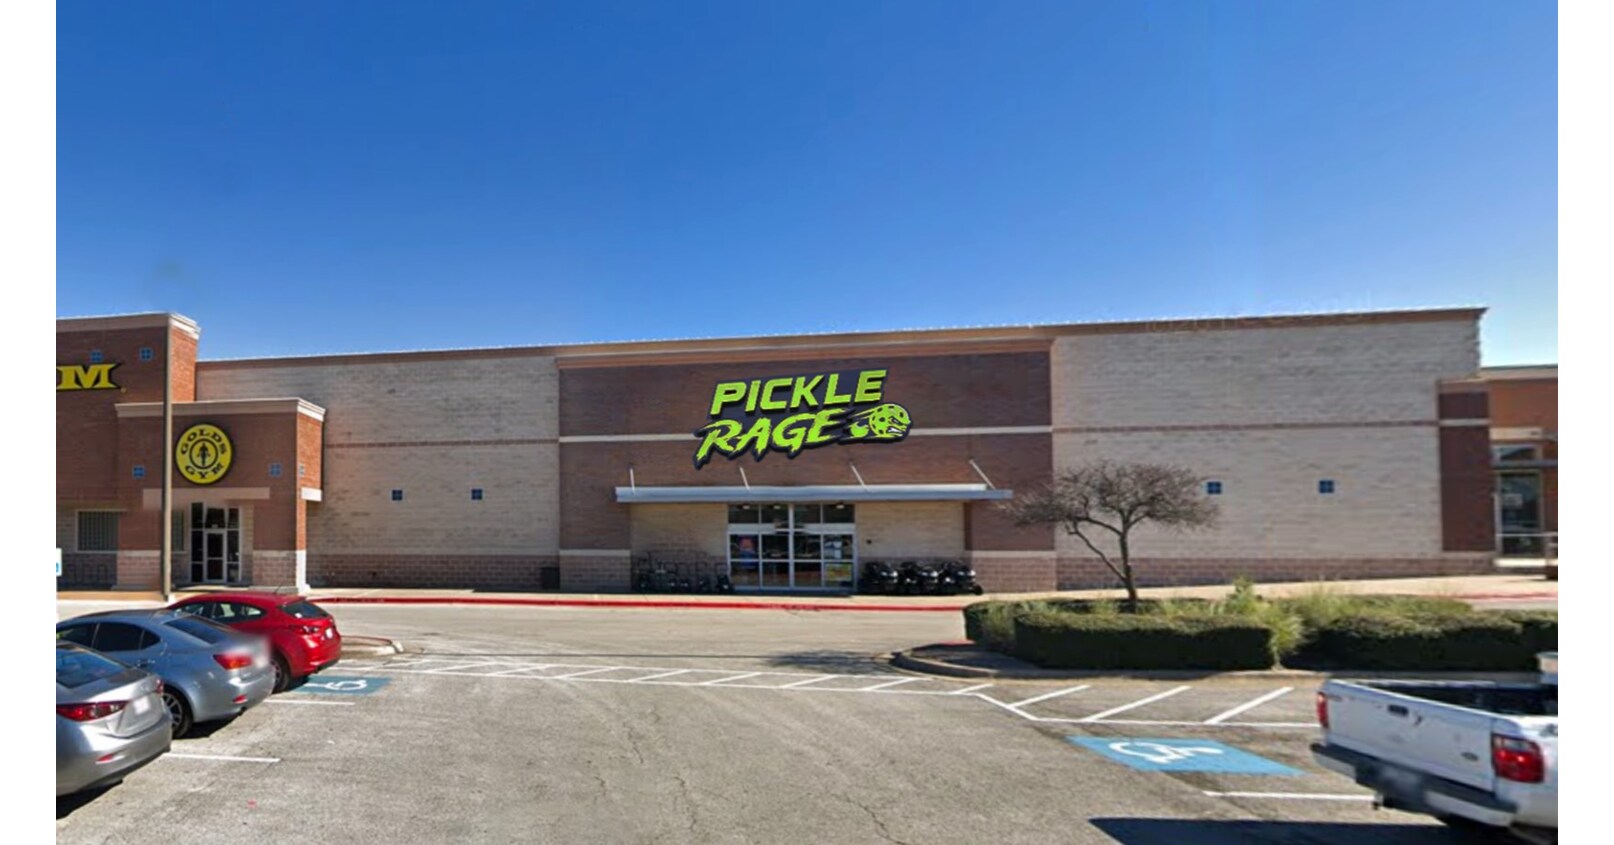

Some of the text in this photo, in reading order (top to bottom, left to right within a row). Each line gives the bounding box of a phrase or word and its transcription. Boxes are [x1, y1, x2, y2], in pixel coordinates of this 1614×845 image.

[710, 369, 887, 415] PICKLE
[696, 408, 850, 461] RAGE
[185, 462, 224, 479] GYM
